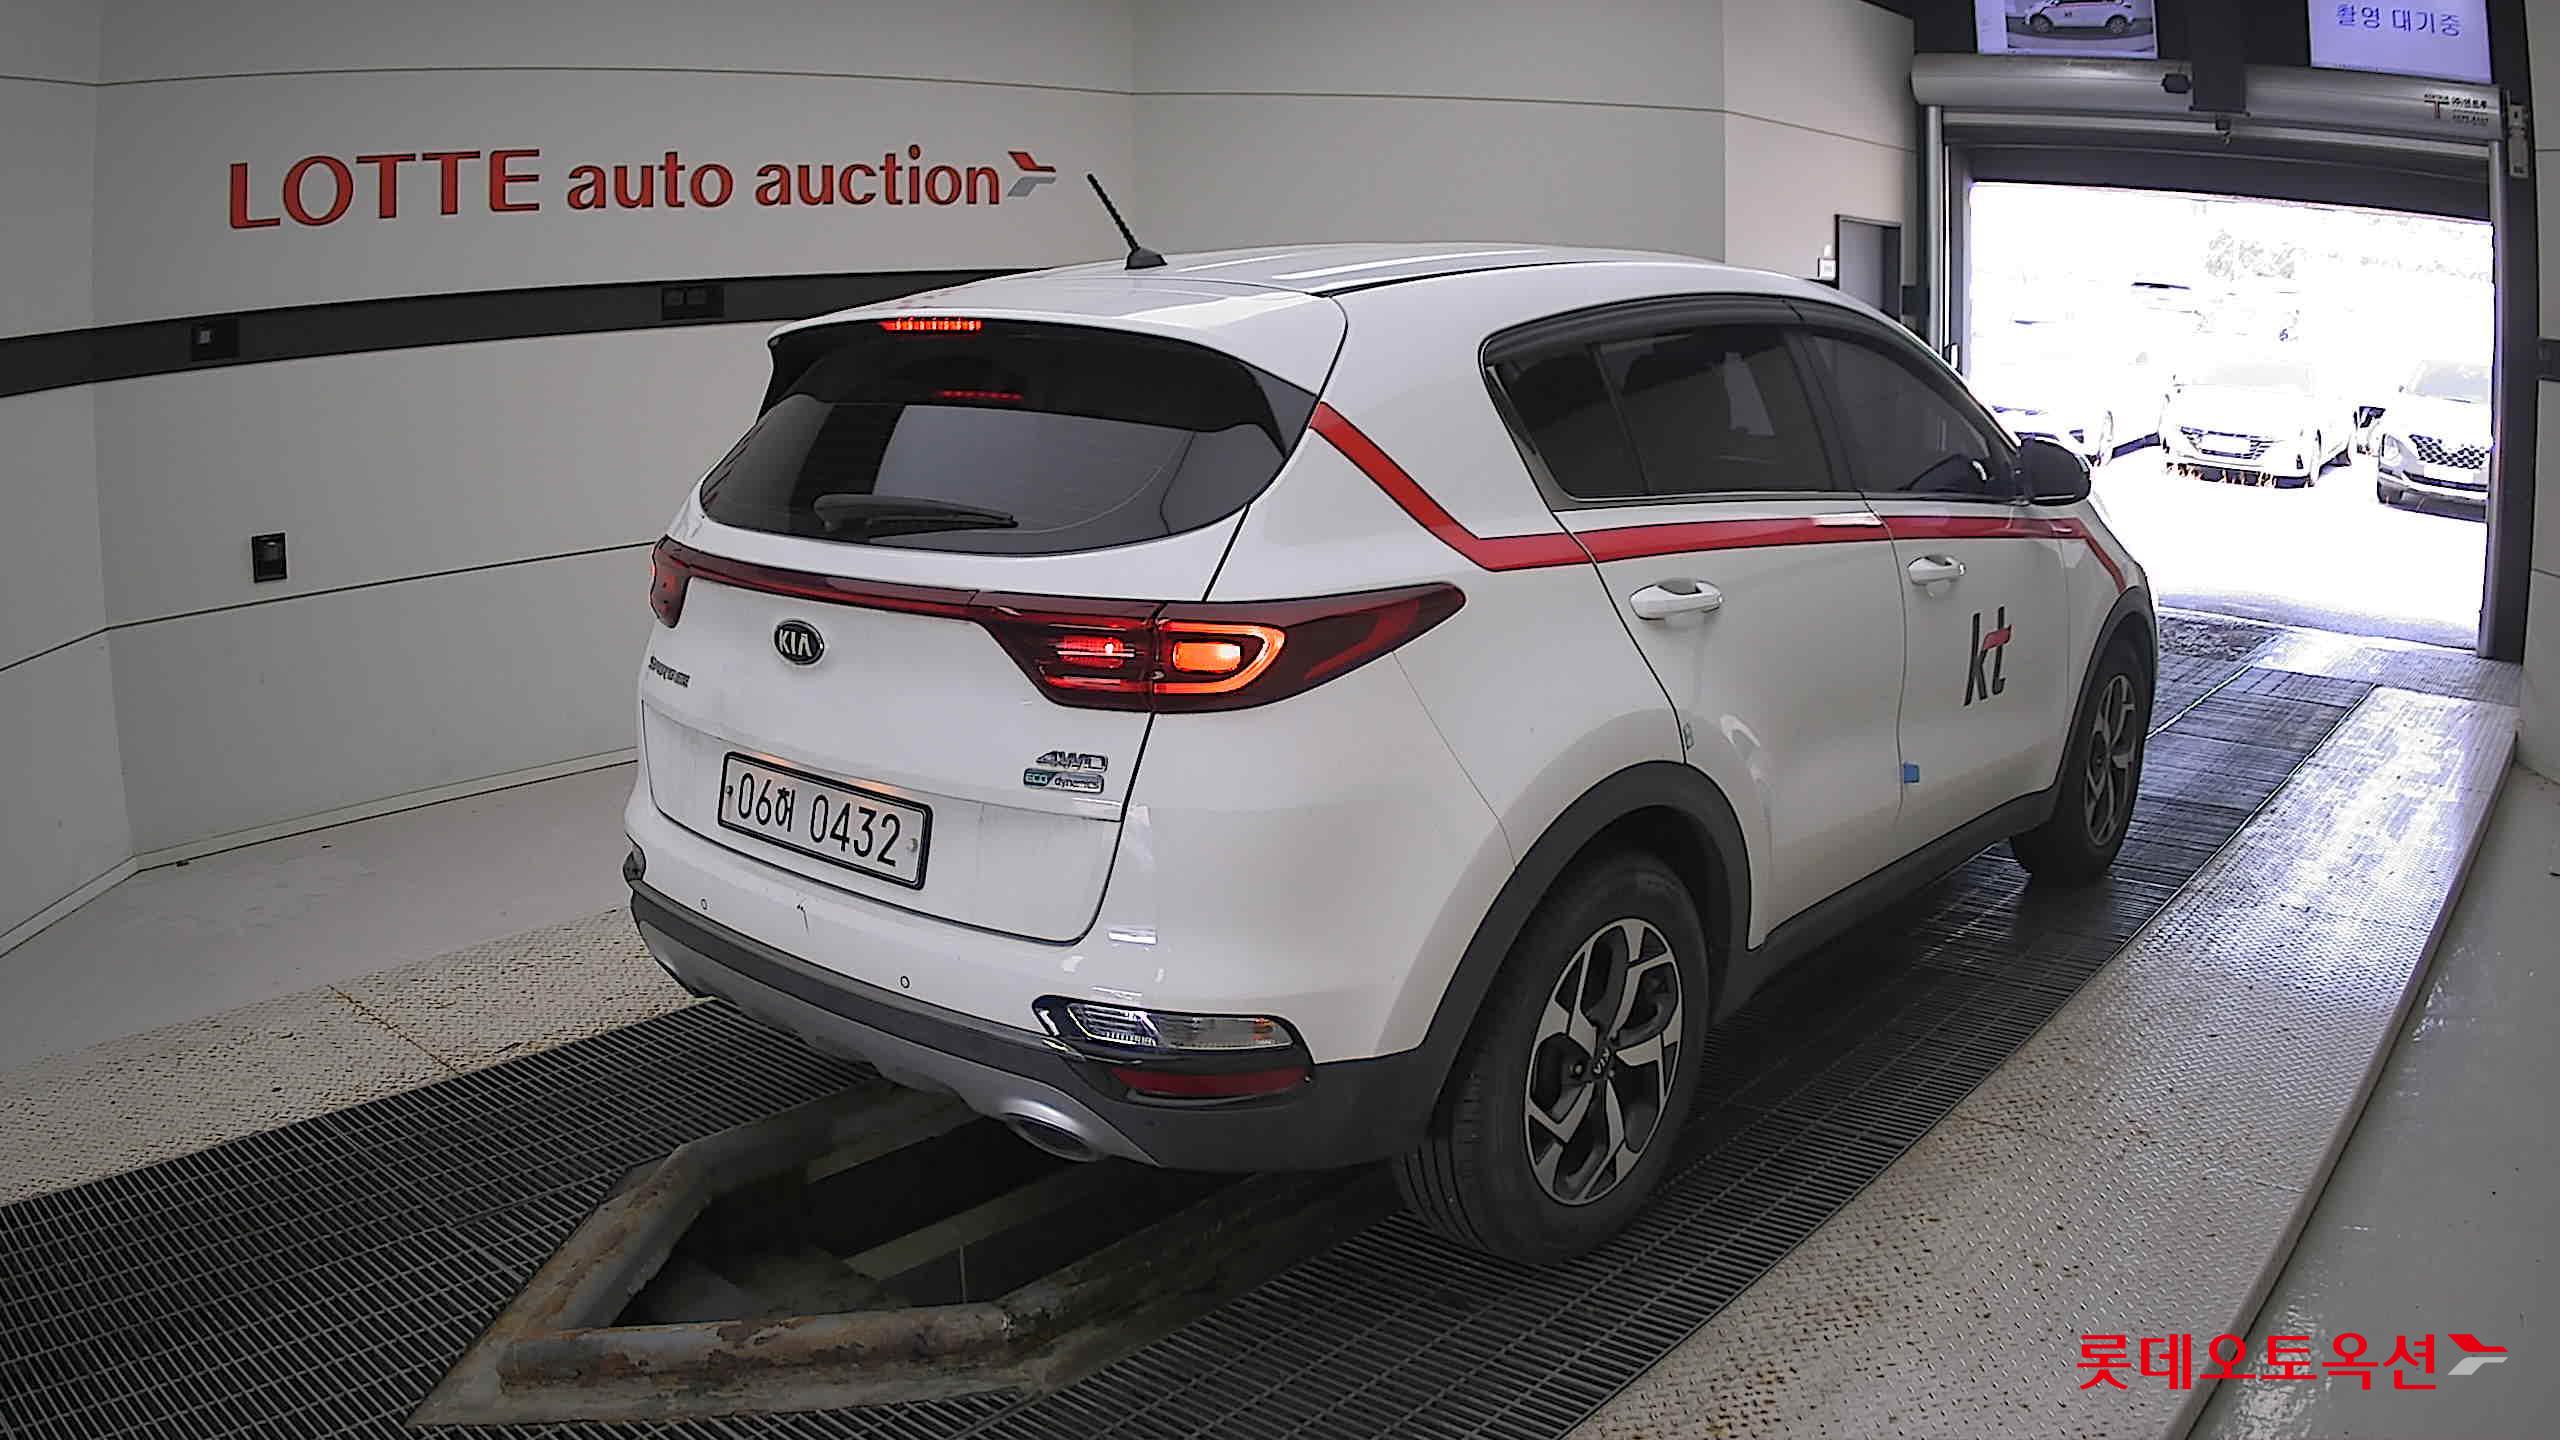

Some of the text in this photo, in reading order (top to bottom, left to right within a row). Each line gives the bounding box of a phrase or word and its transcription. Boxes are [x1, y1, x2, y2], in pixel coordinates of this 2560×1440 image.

[2336, 3, 2462, 37] 촬영 대기중
[229, 143, 1001, 230] LOTTE auto auction
[777, 628, 813, 658] KIA
[1963, 605, 2014, 707] kt
[1035, 750, 1109, 772] 4WD
[737, 772, 902, 867] 06허 0432
